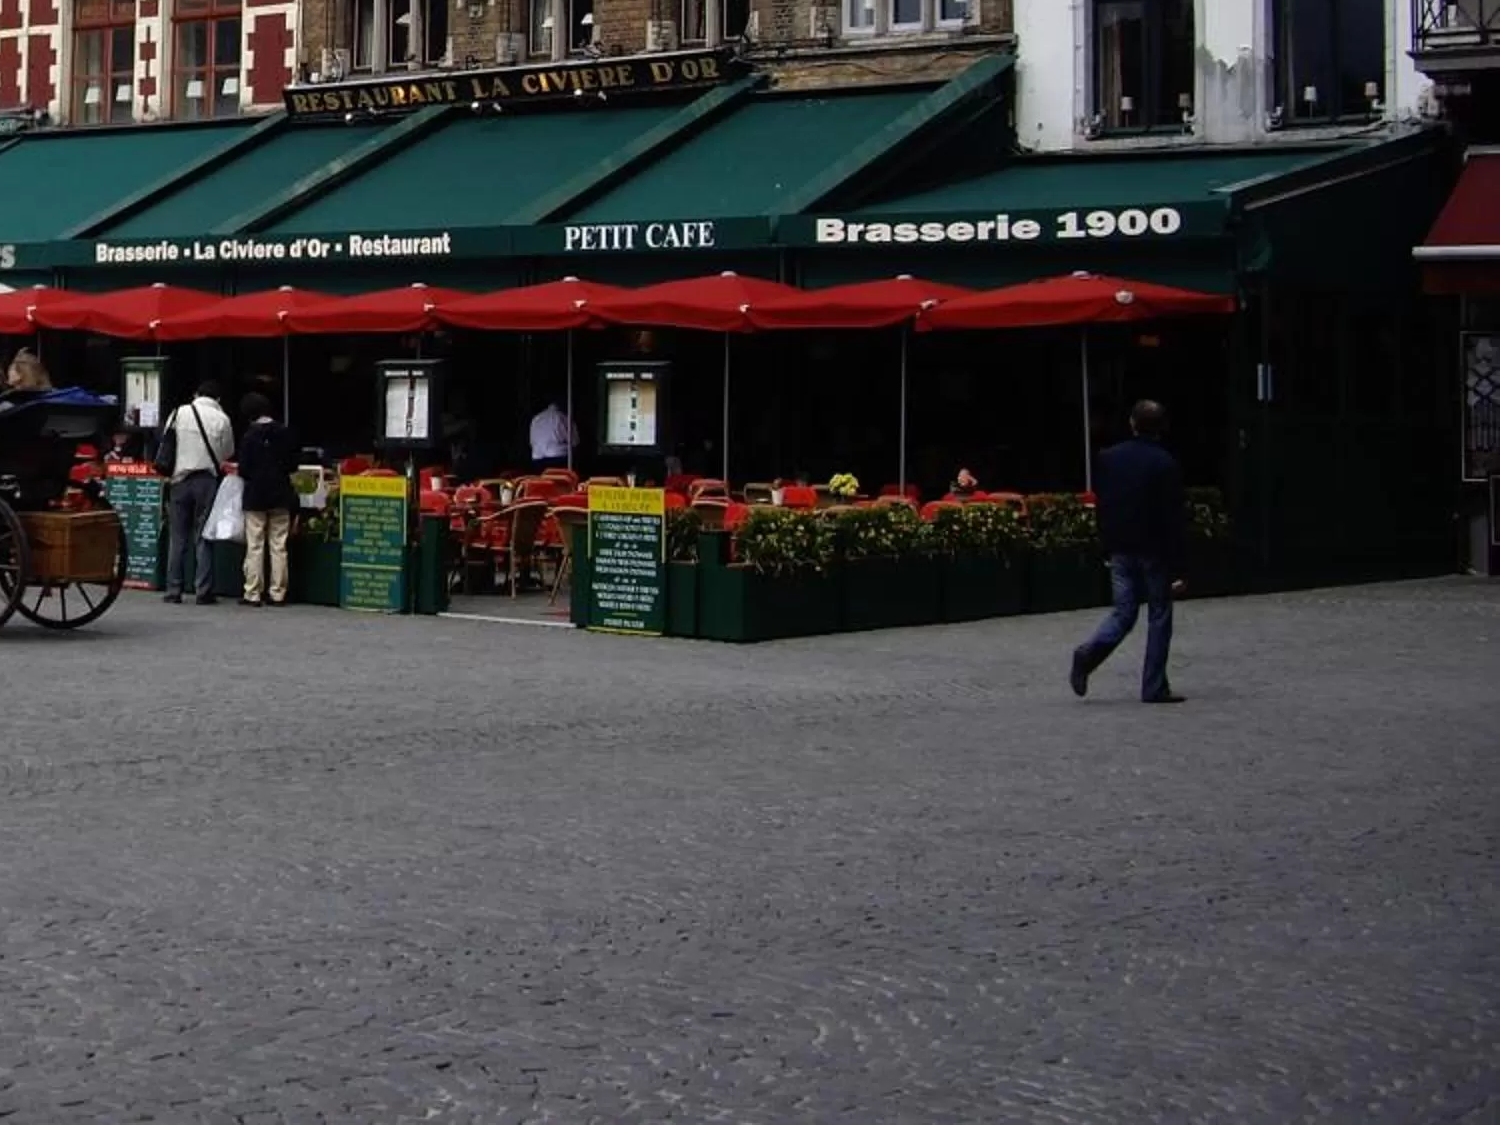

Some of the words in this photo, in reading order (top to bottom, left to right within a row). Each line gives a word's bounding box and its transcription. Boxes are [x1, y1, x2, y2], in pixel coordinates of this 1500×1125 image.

[292, 81, 459, 113] RESTAURANT
[471, 75, 510, 99] LA
[521, 65, 634, 95] CIVIERE
[649, 57, 720, 85] D'OR
[564, 225, 640, 252] PETIT
[645, 221, 716, 249] CAFE
[816, 214, 1042, 244] Brasserie
[1056, 208, 1182, 239] 1900
[96, 242, 180, 264] Brasserie
[194, 242, 217, 261] La
[219, 239, 285, 260] Civiere
[289, 238, 331, 259] d'Or
[349, 234, 452, 257] Restaurant
